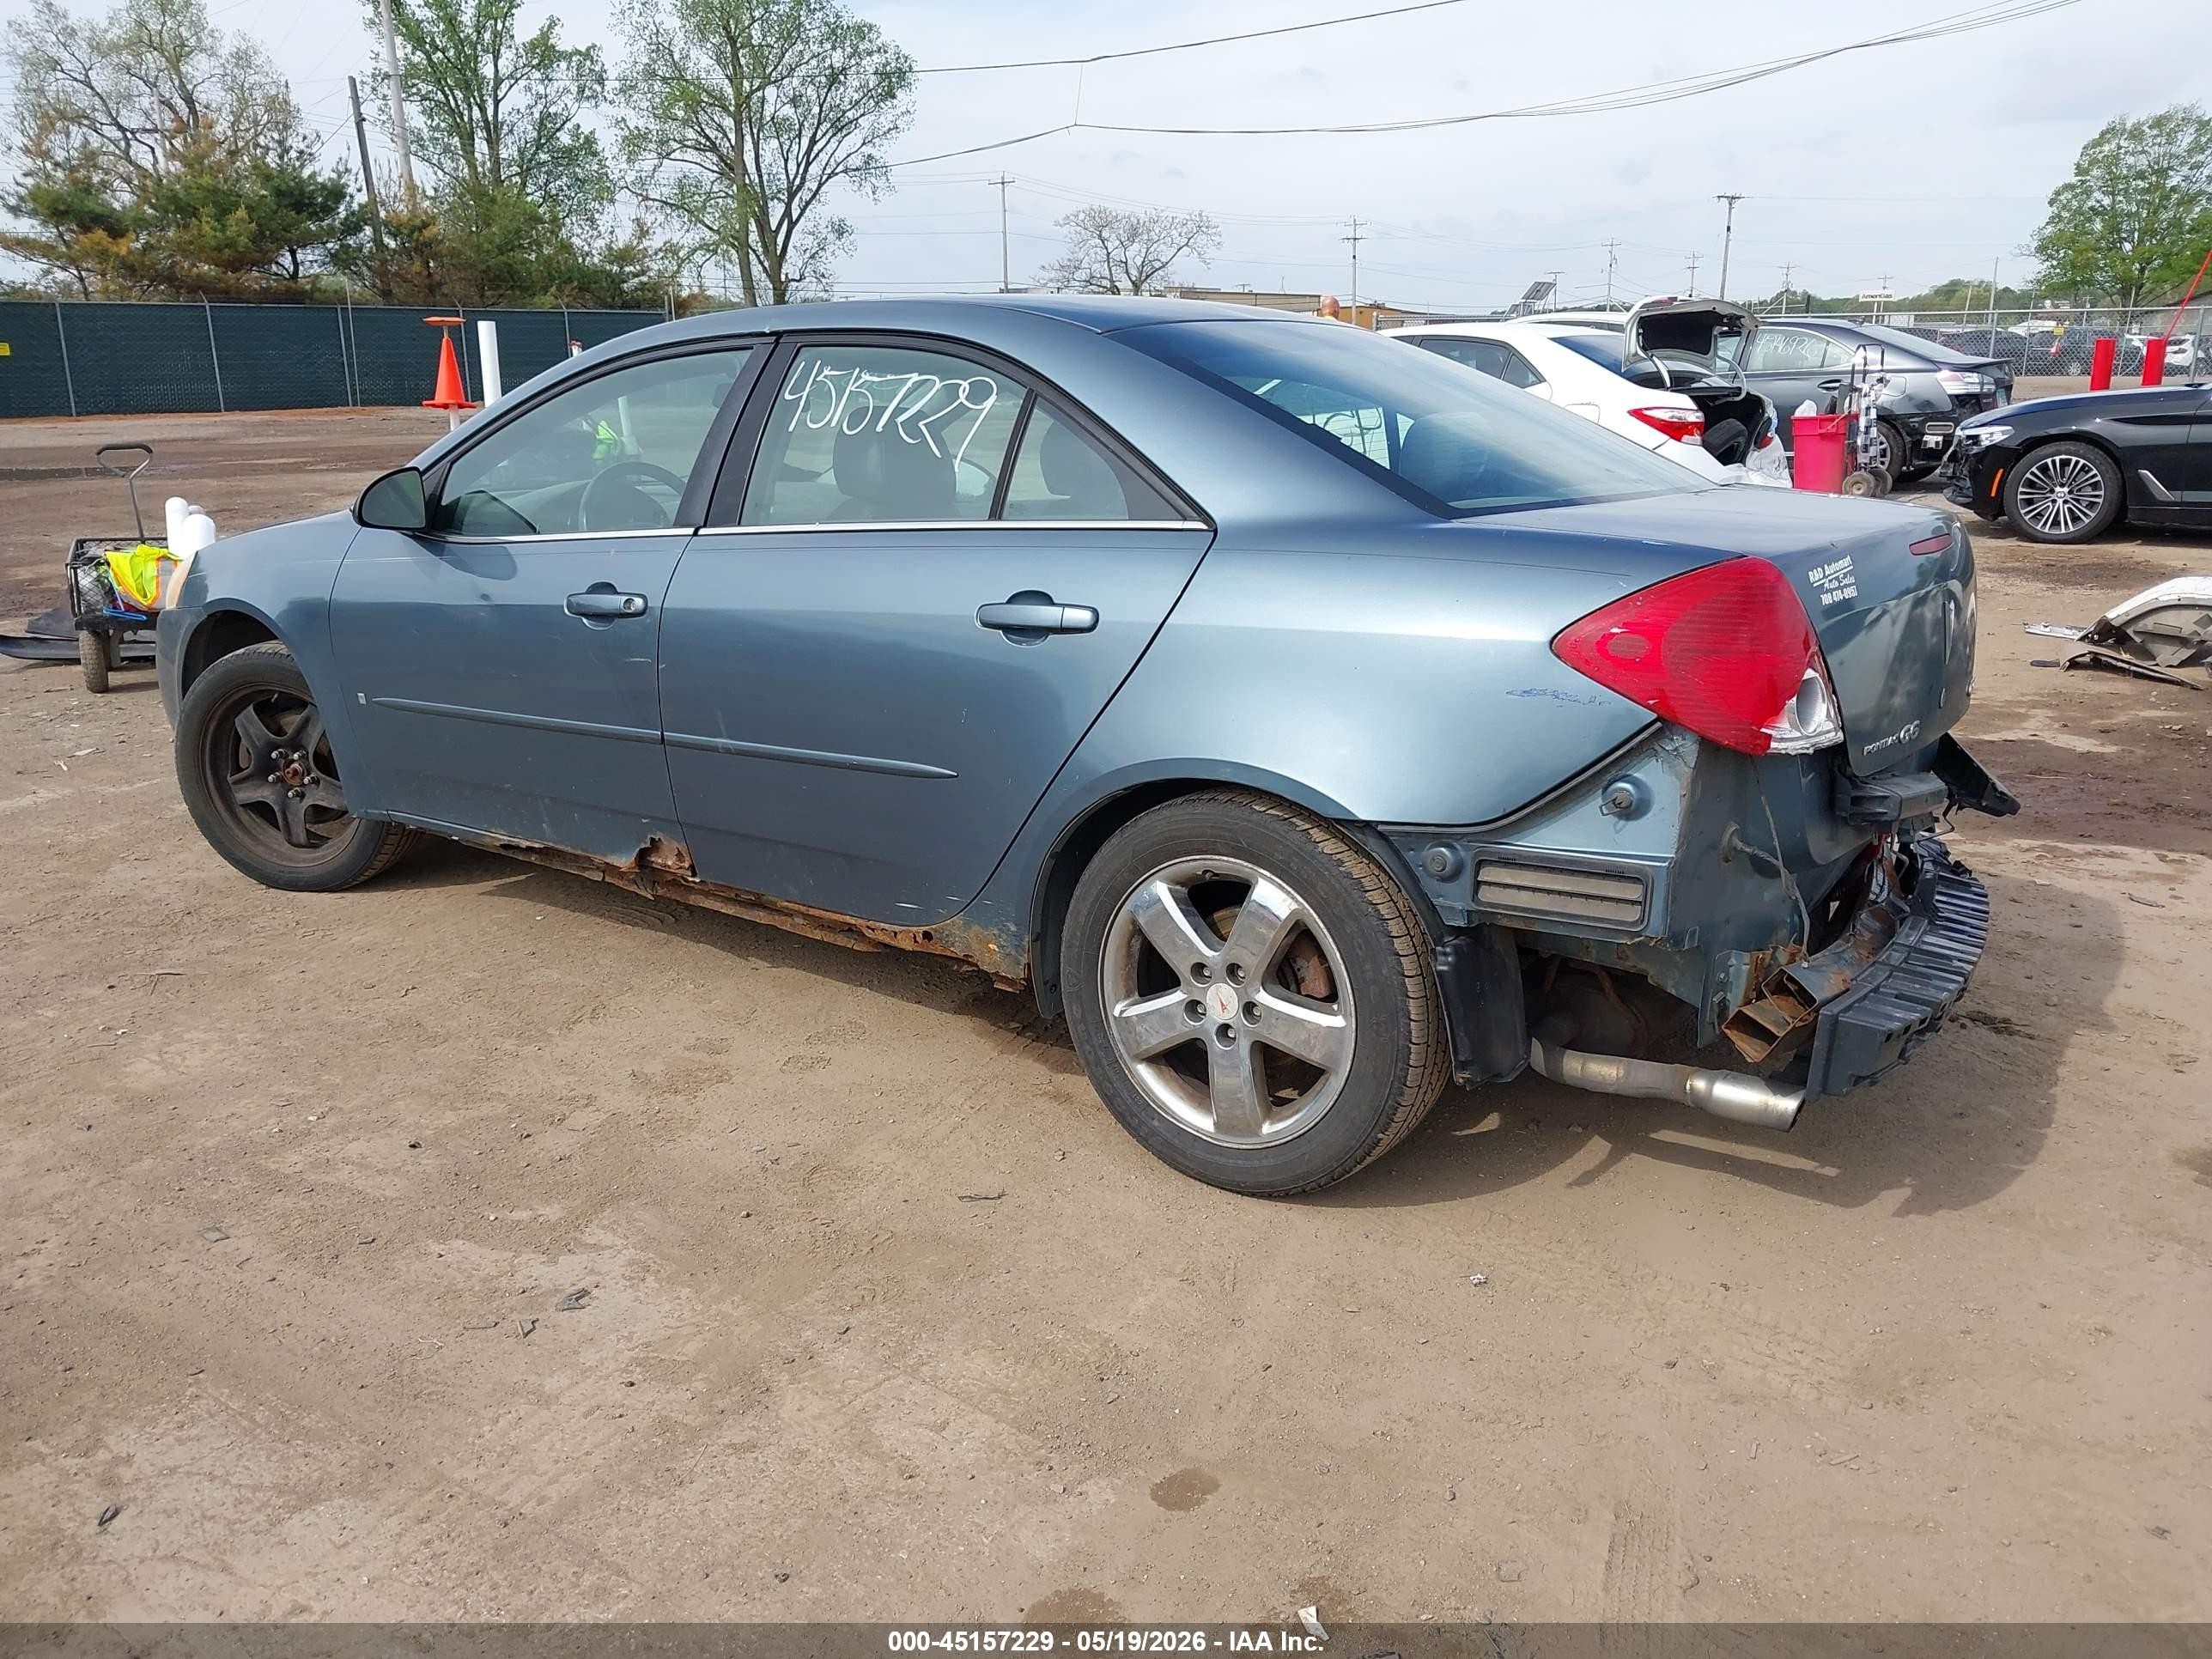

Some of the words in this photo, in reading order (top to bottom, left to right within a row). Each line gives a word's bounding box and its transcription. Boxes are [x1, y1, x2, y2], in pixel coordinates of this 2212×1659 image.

[784, 360, 998, 473] 45157229
[1808, 568, 1824, 583] R&D
[1824, 555, 1852, 576] Automart
[1824, 579, 1838, 592] Auto
[1839, 574, 1855, 586] Sales
[1820, 592, 1832, 605] 708
[1863, 733, 1899, 756] PONTIAC
[1899, 720, 1920, 744] G6
